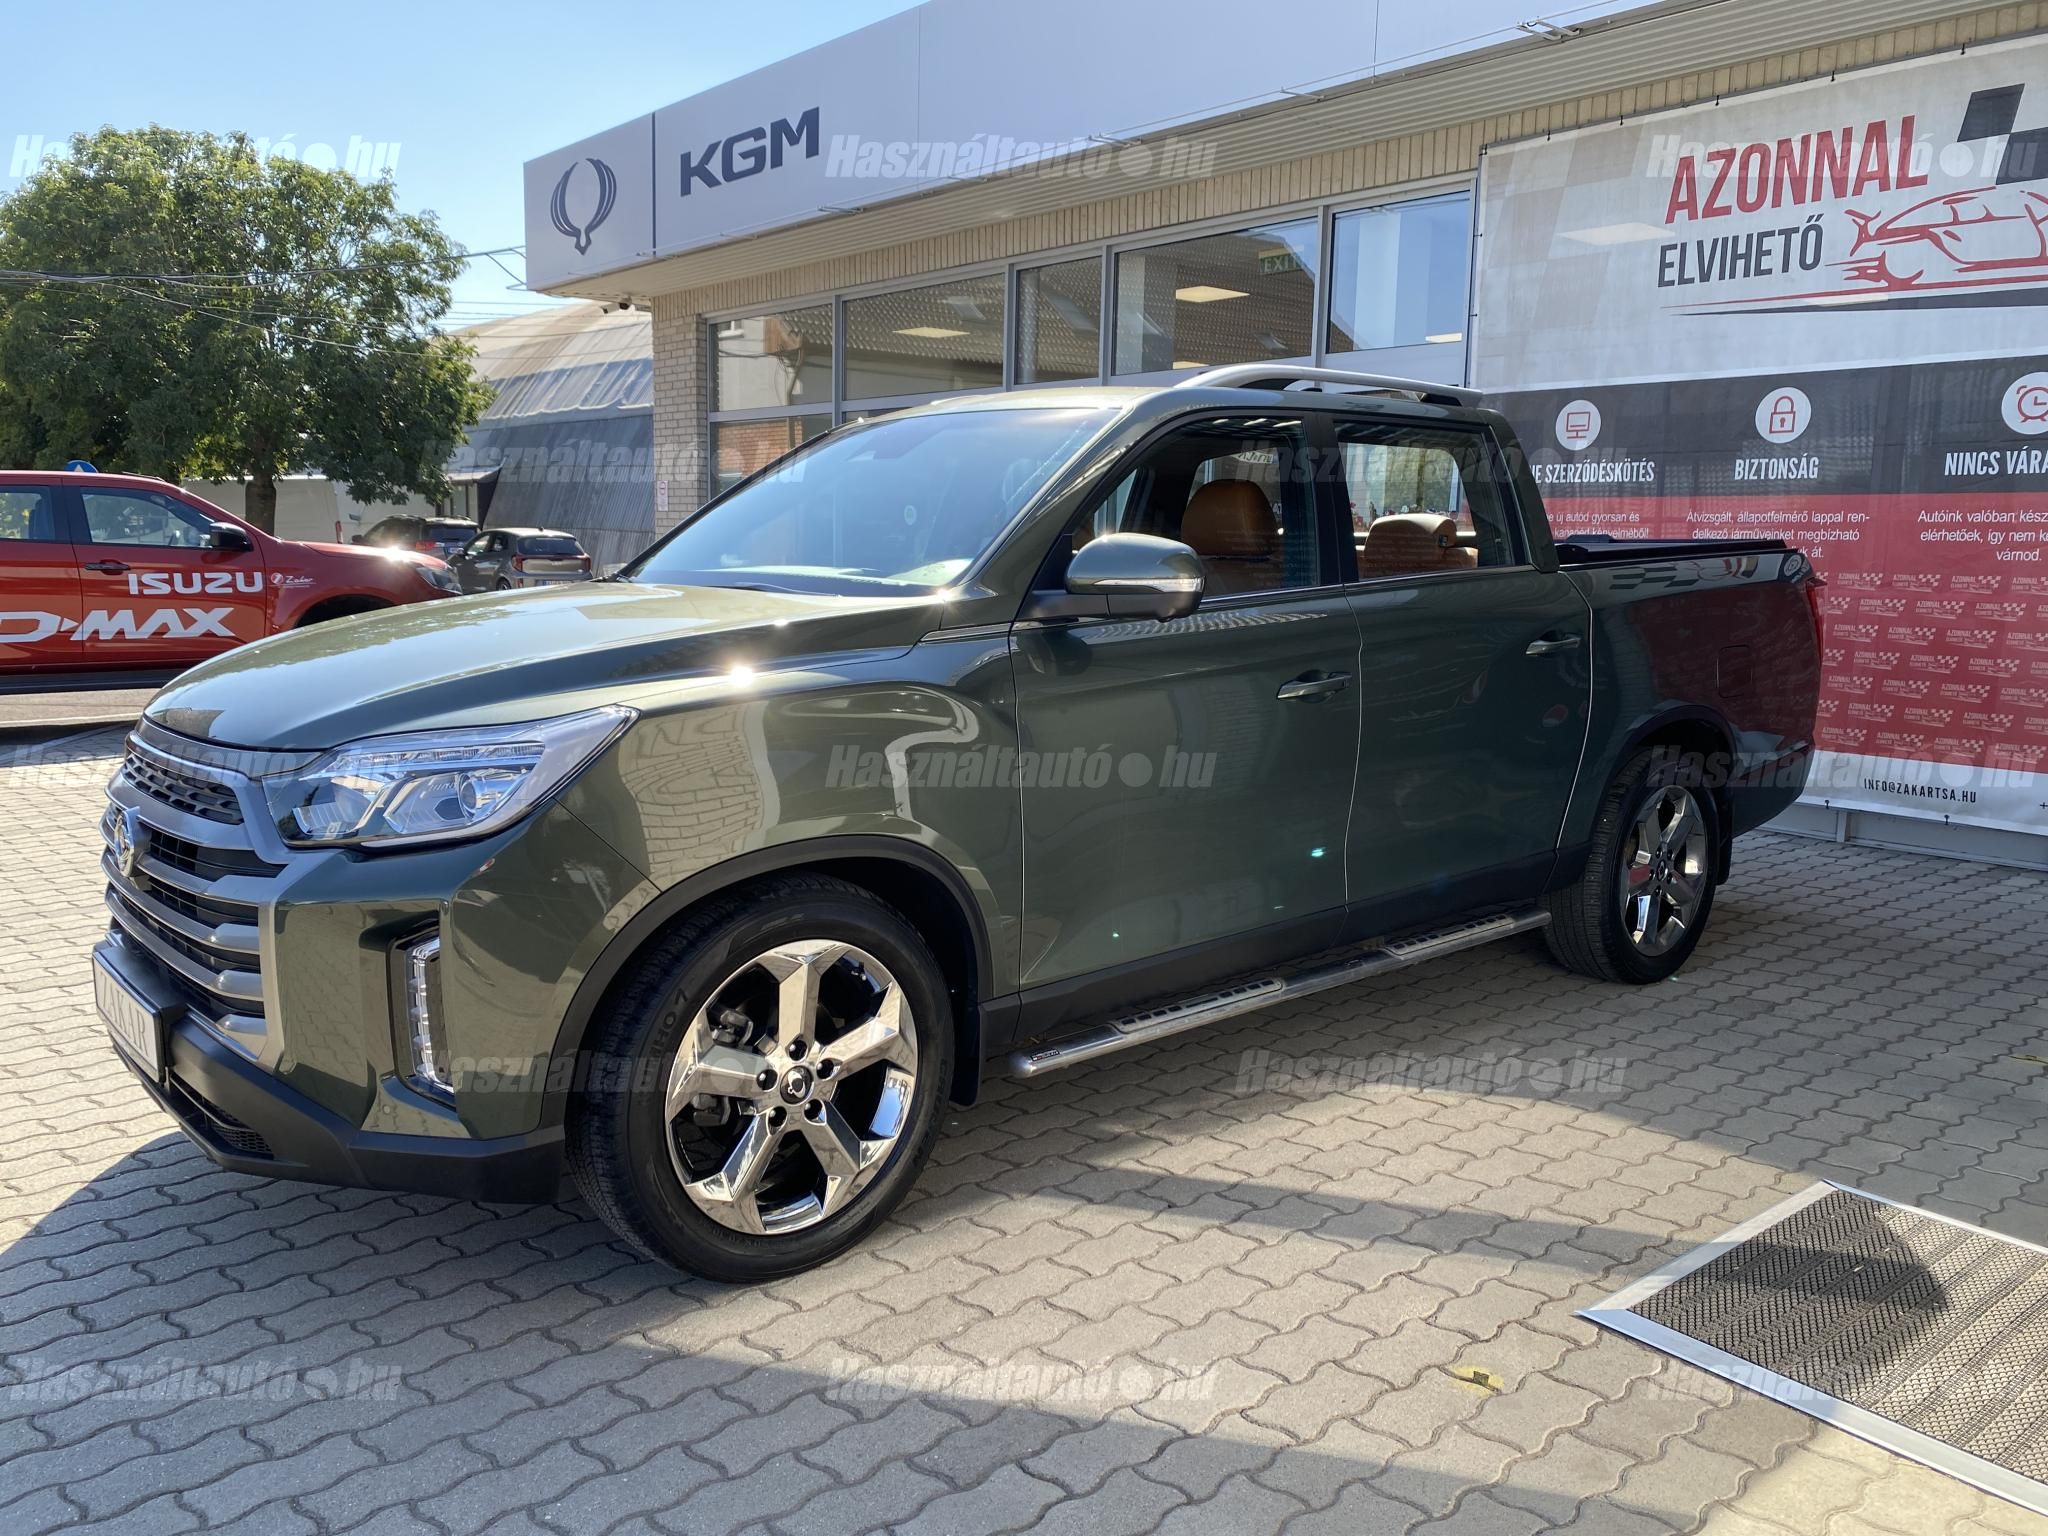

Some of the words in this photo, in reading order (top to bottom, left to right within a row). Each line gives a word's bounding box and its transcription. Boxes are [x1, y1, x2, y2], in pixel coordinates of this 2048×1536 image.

[680, 106, 820, 198] KGM
[1664, 115, 1928, 224] AZONNAL
[1657, 213, 1824, 288] ELVIHETŐ
[1545, 458, 1655, 483] SZERZŐDÉSKÖTÉS
[1734, 453, 1819, 480] BIZTONSÁG
[1944, 451, 2000, 476] NINCS
[1566, 512, 1589, 522] autód
[1591, 513, 1627, 525] gyorsan
[1629, 512, 1640, 522] és
[1737, 510, 1808, 526] állapotfelmérő
[1812, 510, 1843, 526] lappal
[1847, 513, 1870, 523] ren-
[1918, 510, 1963, 523] Autóink
[1966, 510, 2015, 523] valóban
[1692, 527, 1728, 540] delkező
[1797, 527, 1860, 543] megbízható
[1920, 528, 1984, 544] elérhetőek,
[1987, 528, 2005, 545] így
[2009, 530, 2036, 542] nem
[1996, 548, 2042, 561] várnod.
[128, 571, 263, 595] ISUZU
[1863, 778, 1976, 803] INFO@ZAKARTSA.HU
